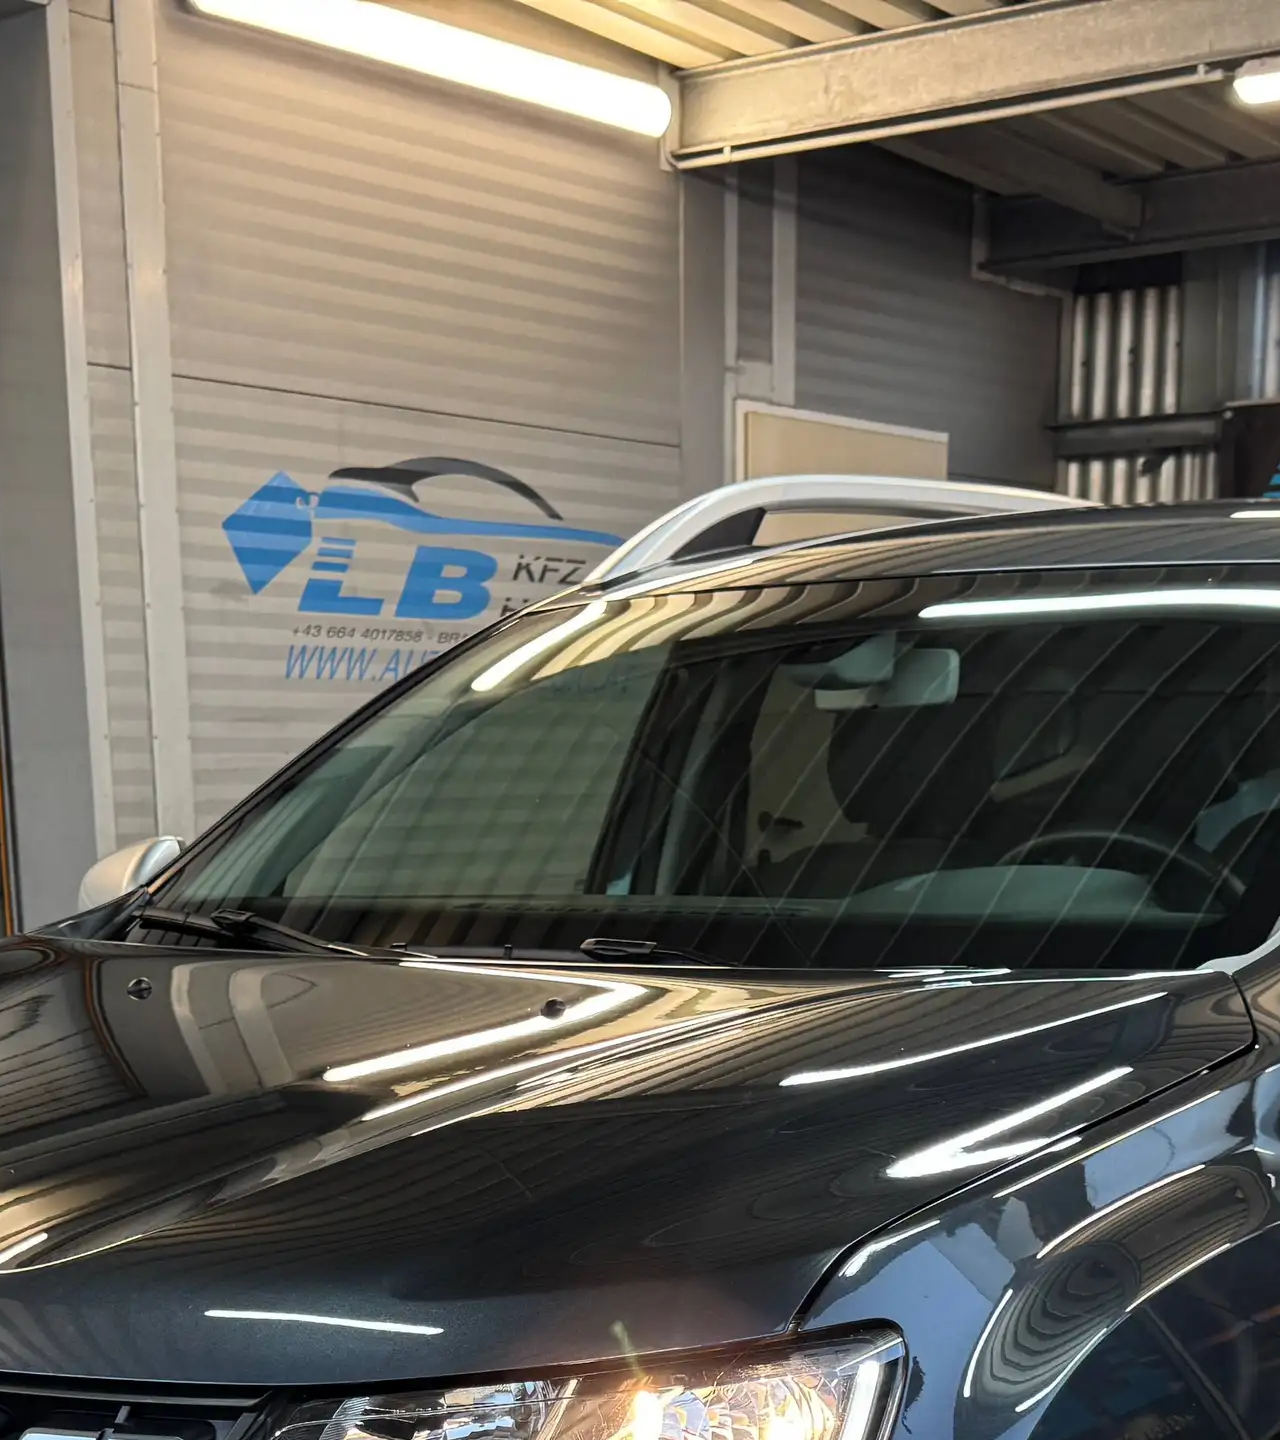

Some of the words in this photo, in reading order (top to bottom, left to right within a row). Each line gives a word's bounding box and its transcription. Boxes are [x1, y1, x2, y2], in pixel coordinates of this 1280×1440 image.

[297, 536, 499, 620] LB
[512, 554, 587, 586] KFZ
[292, 624, 323, 638] +43
[326, 626, 356, 639] 664
[360, 627, 424, 643] 4017858
